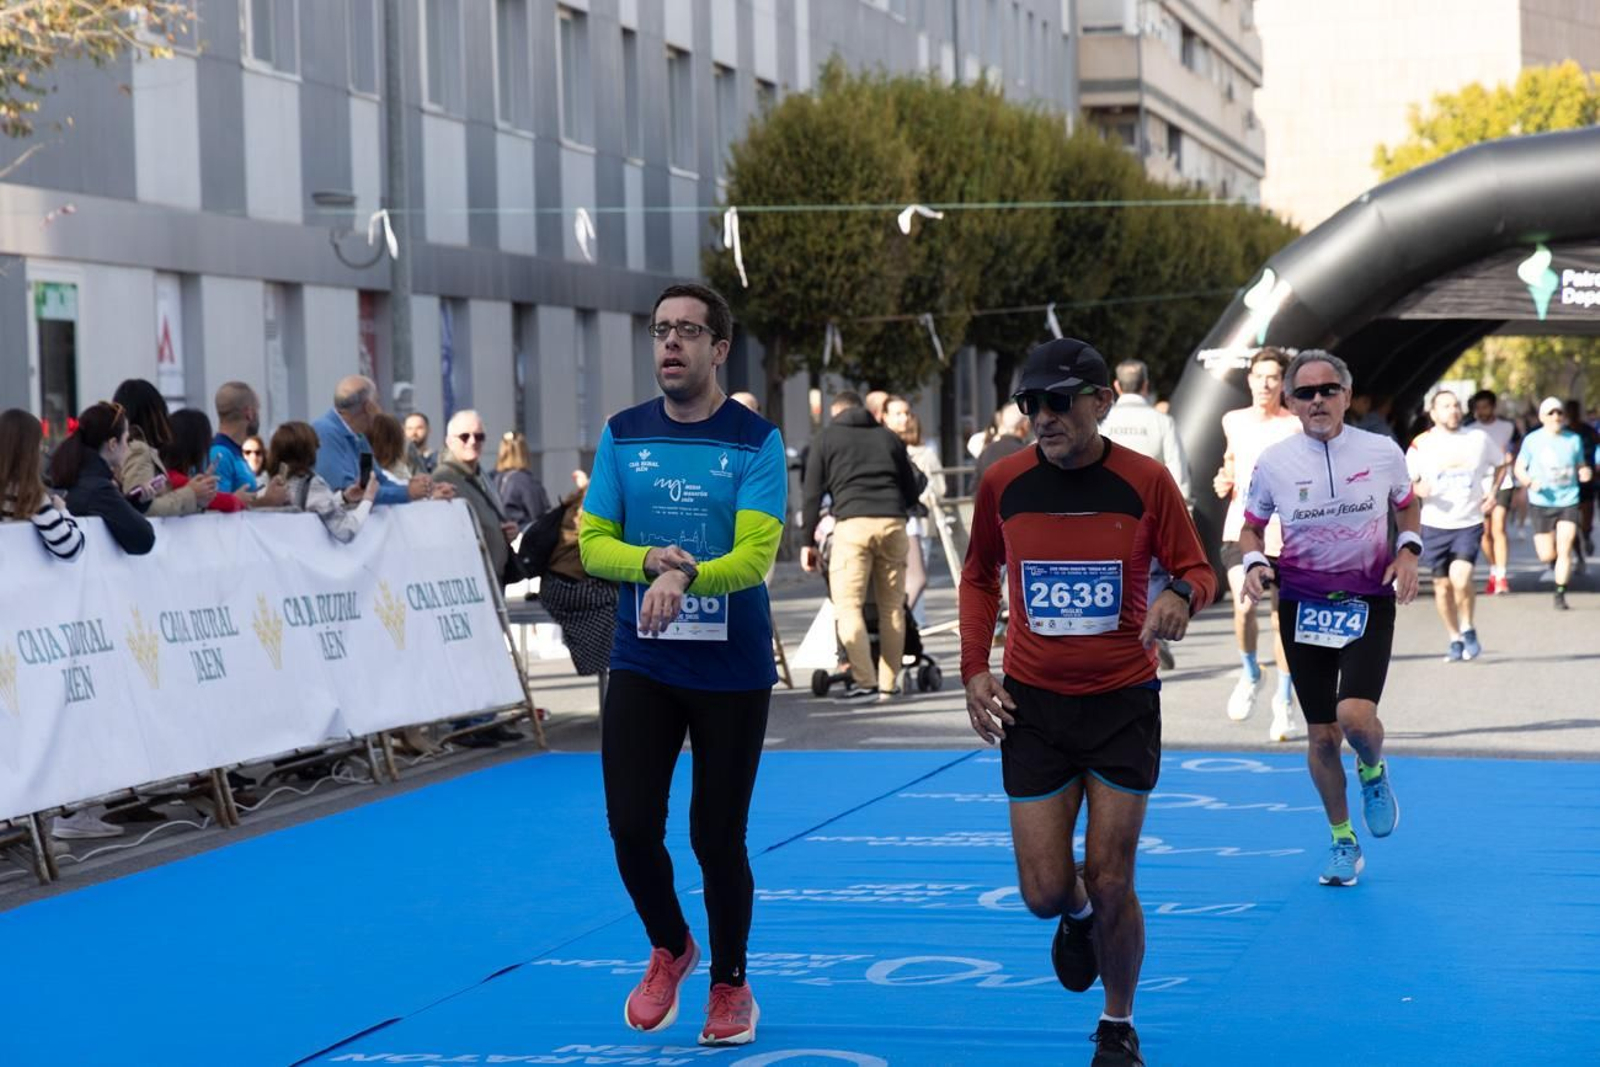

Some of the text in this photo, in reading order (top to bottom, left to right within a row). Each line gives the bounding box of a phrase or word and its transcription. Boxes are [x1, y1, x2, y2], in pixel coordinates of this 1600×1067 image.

[1291, 508, 1325, 522] SIERRA
[1335, 502, 1373, 517] SEGURA
[437, 577, 485, 607] RURAL
[1030, 582, 1115, 608] 2638
[189, 606, 240, 641] RURAL
[1302, 608, 1362, 632] 2074
[17, 627, 67, 665] CAJA
[317, 625, 347, 661] AÉN
